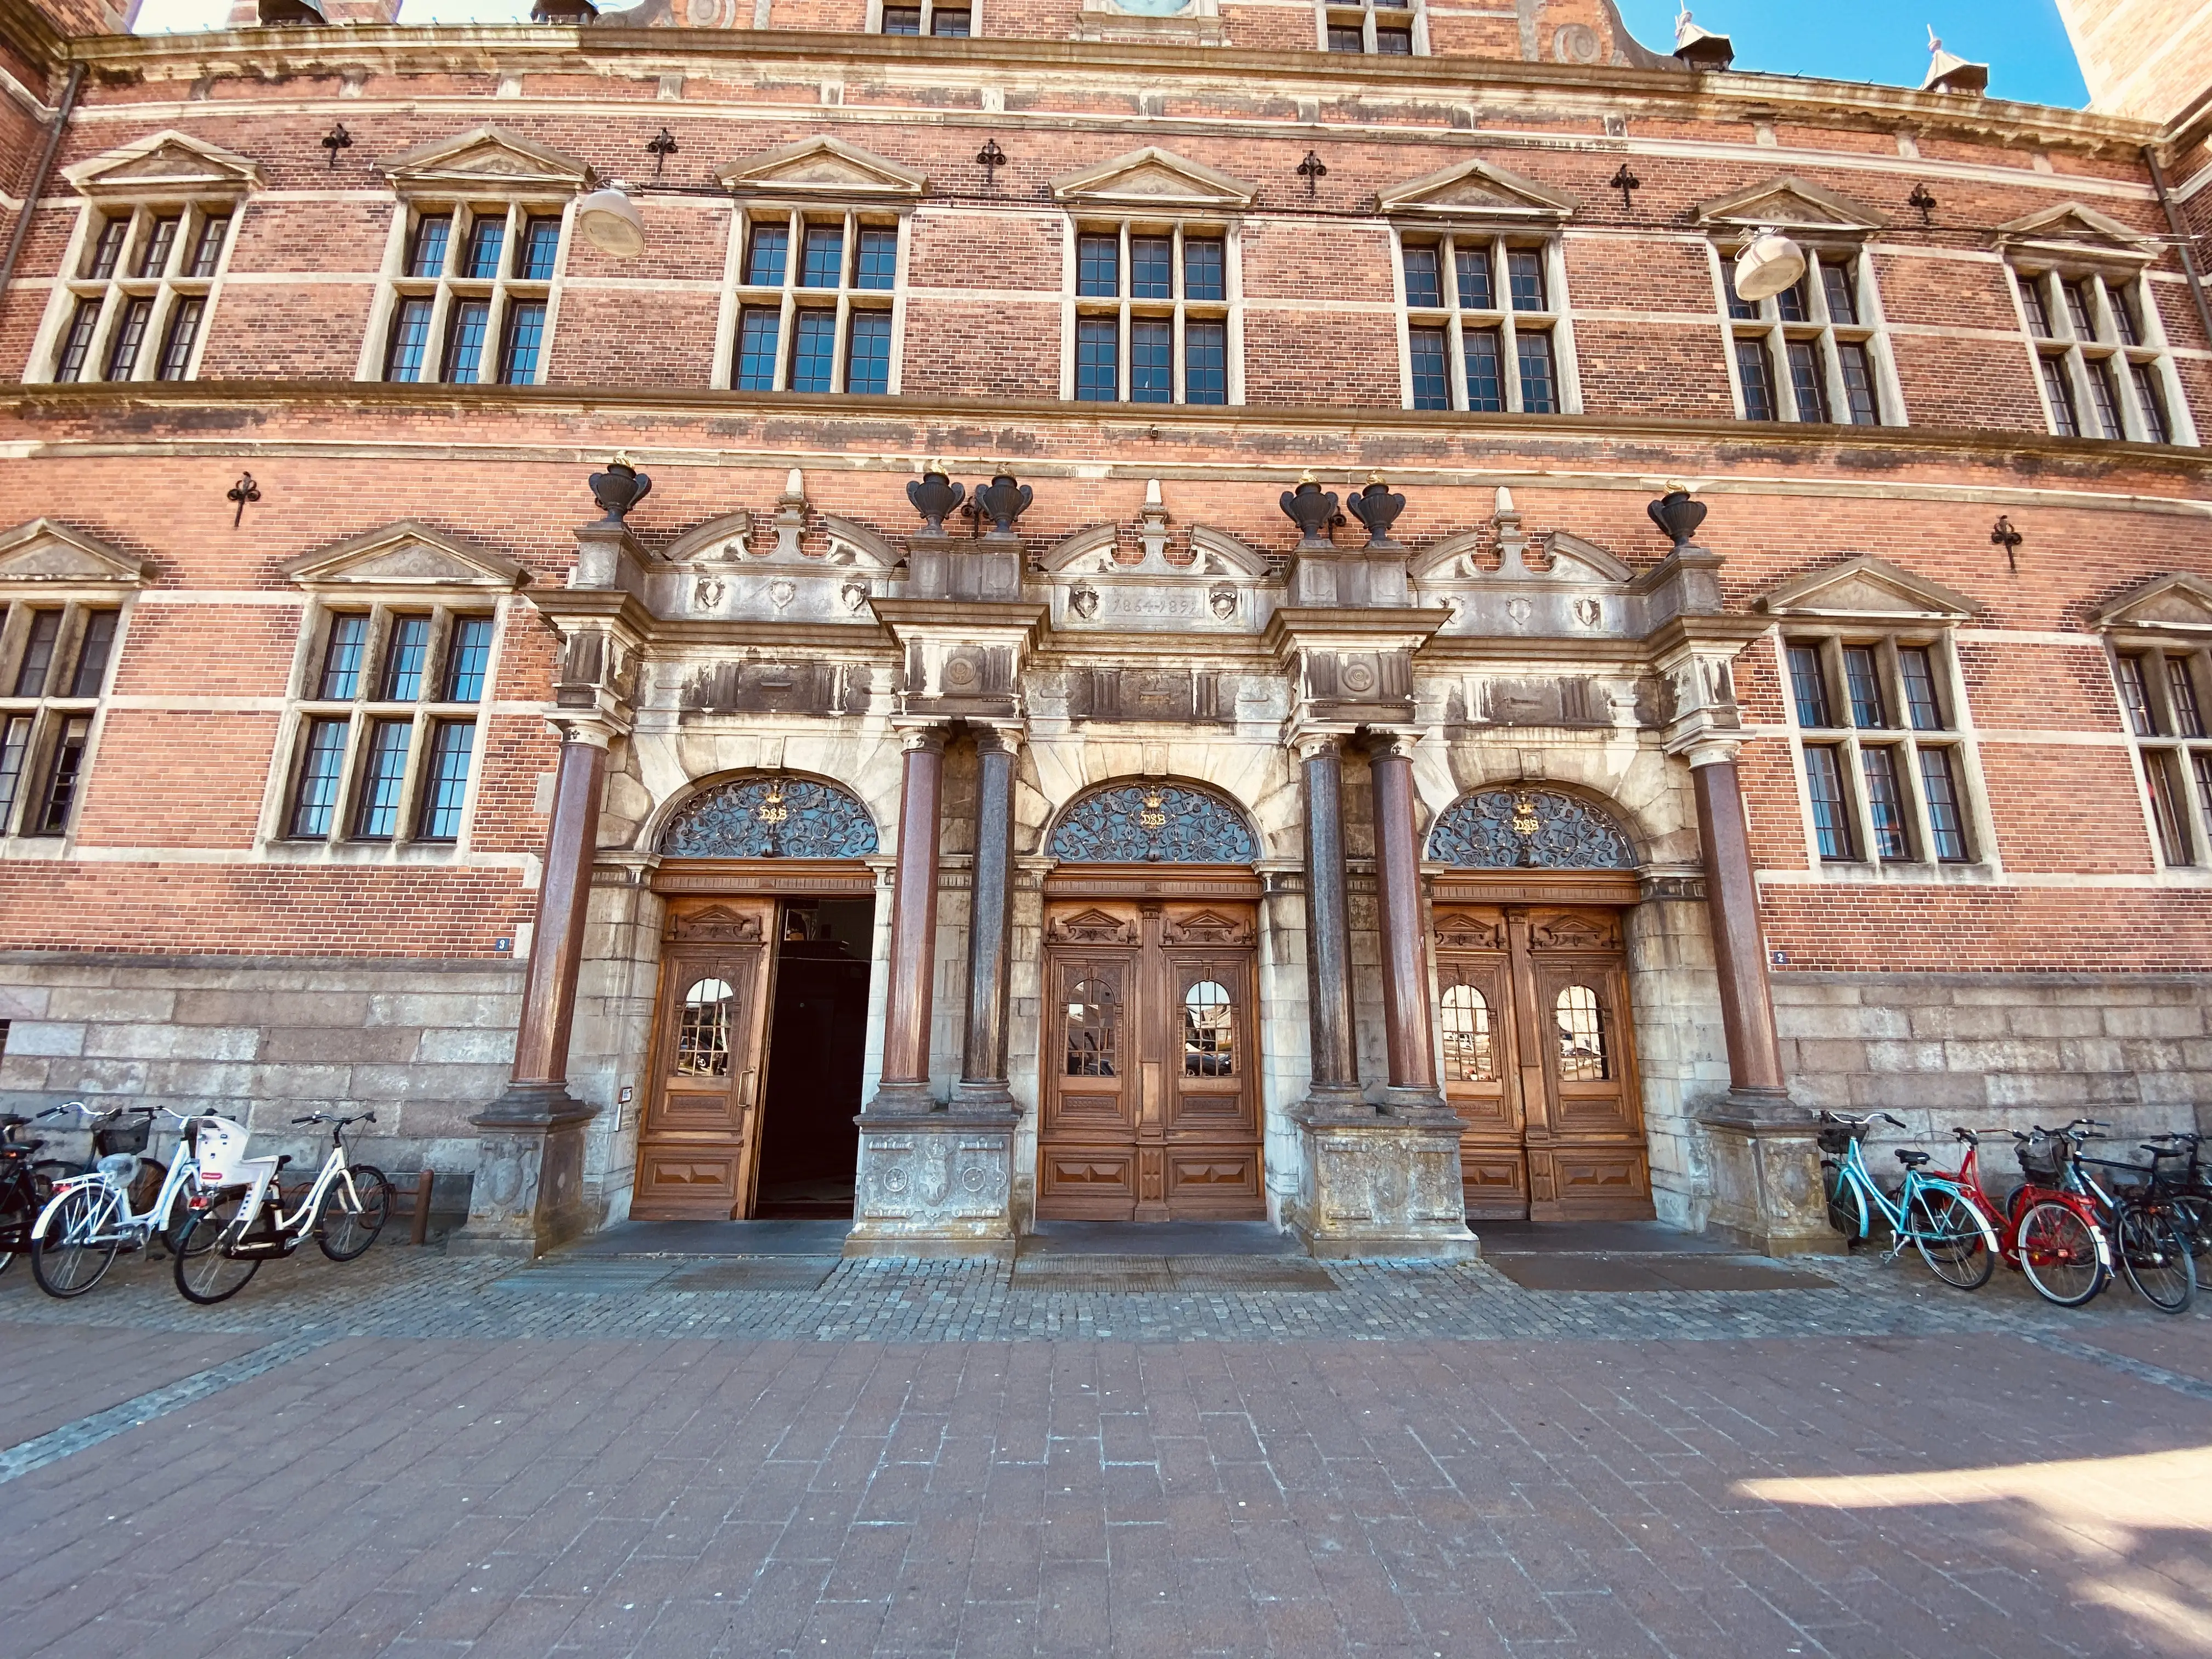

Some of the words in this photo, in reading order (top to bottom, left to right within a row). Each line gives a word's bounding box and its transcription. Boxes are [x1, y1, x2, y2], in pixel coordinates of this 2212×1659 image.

[758, 805, 787, 824] DSB
[1141, 810, 1166, 829] DSB
[1513, 816, 1539, 834] DSB
[499, 939, 505, 949] 3
[1778, 953, 1784, 962] 2
